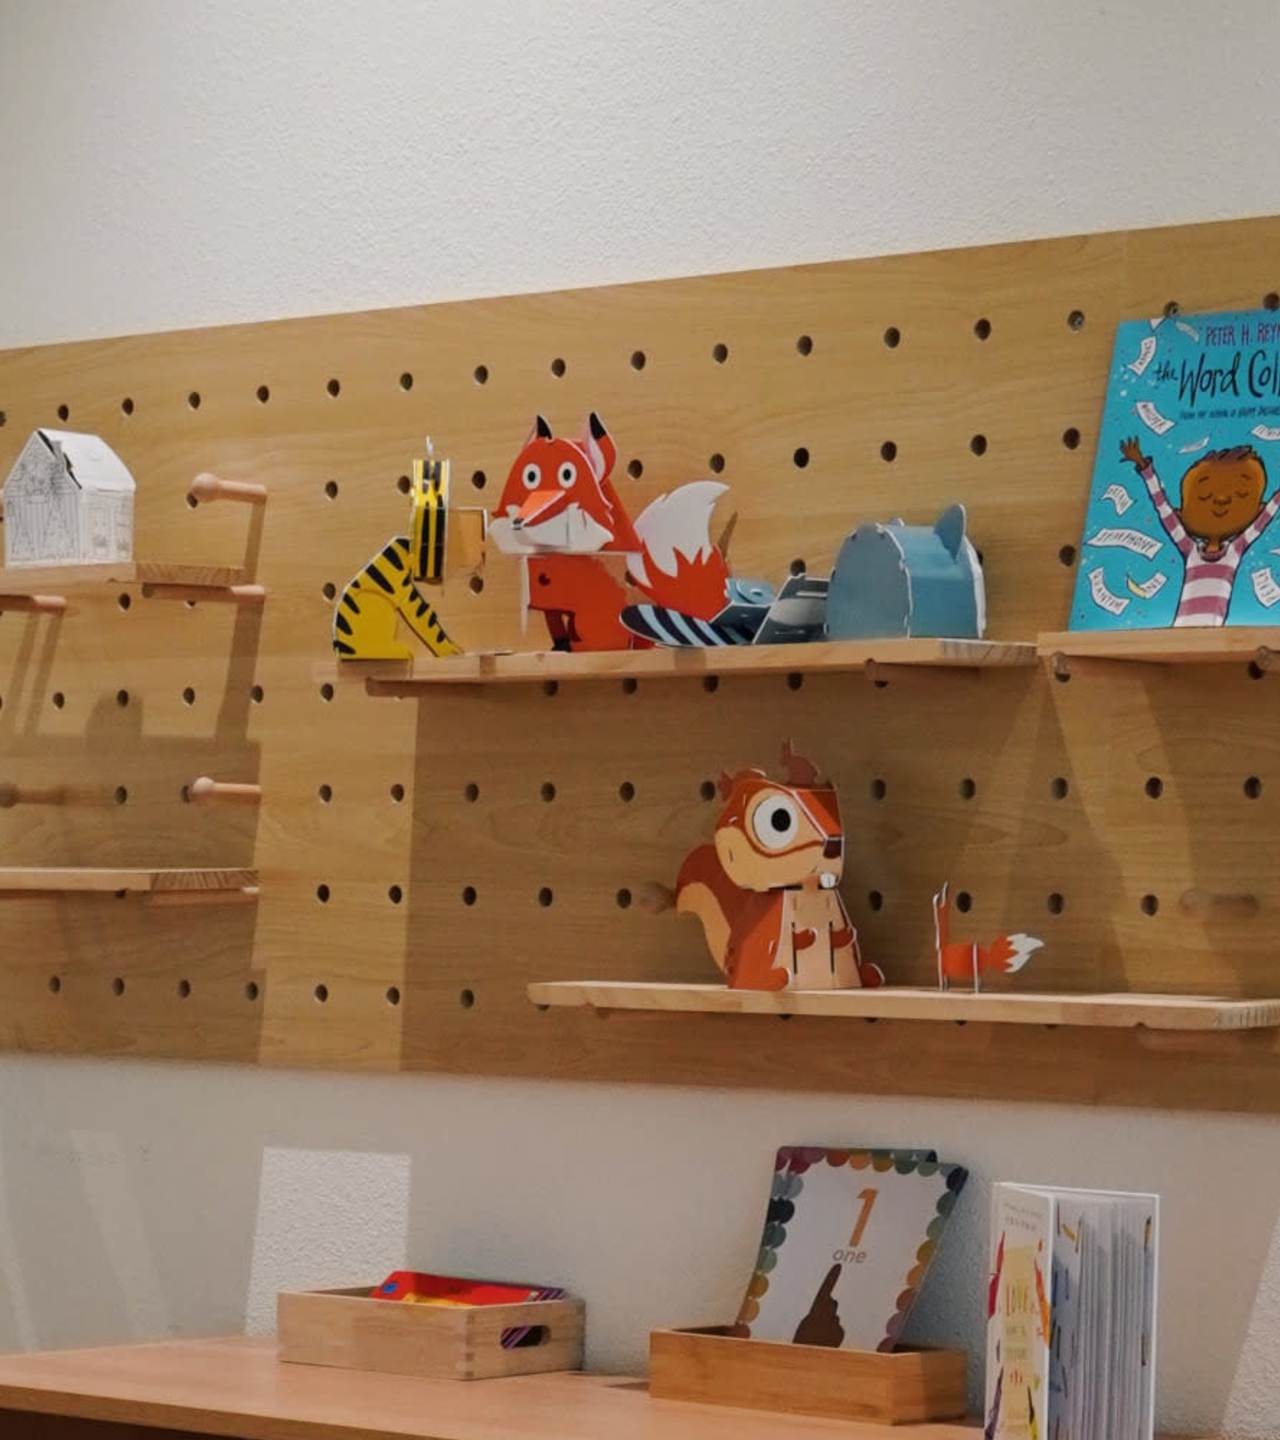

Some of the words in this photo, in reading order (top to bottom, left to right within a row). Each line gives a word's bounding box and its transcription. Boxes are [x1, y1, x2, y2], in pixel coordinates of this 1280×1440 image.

[1206, 325, 1235, 347] PETER
[1241, 323, 1252, 345] H.
[1153, 360, 1178, 382] the
[1178, 351, 1241, 407] Word
[849, 1188, 879, 1248] 1
[832, 1249, 867, 1264] one
